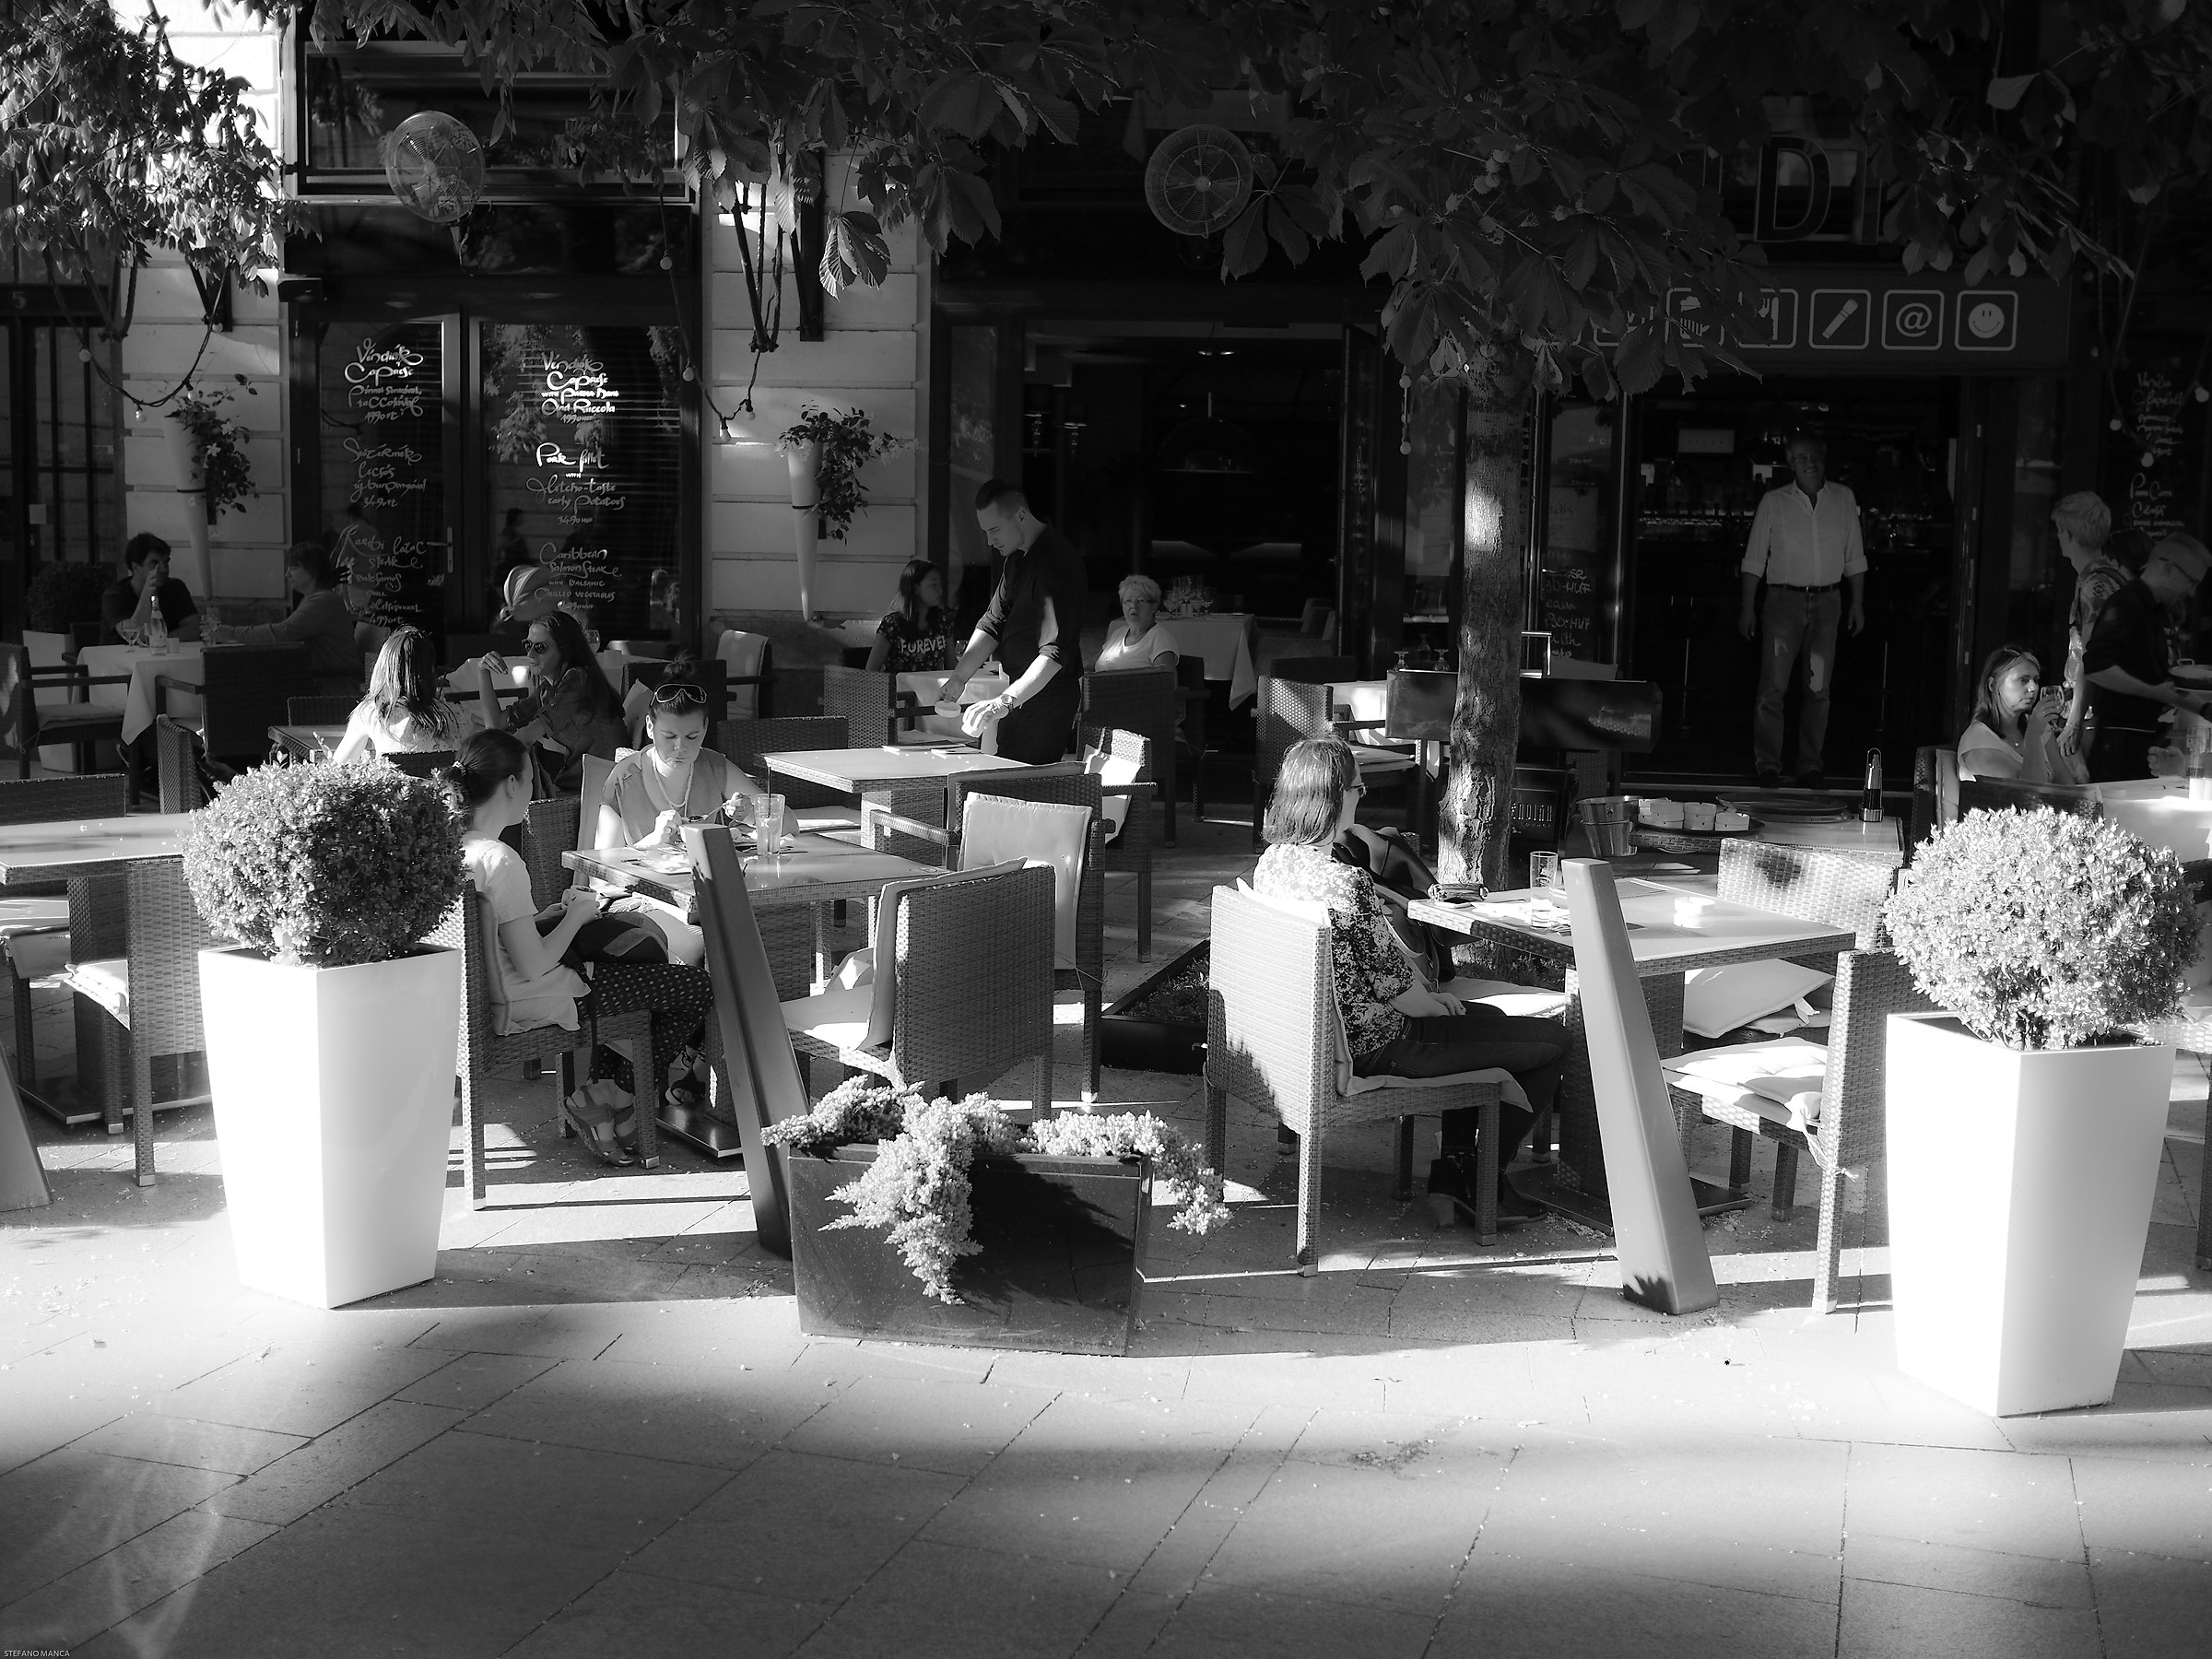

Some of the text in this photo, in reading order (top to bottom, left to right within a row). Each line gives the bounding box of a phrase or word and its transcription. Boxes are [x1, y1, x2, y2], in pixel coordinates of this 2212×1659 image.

[12, 290, 26, 309] 5
[572, 398, 616, 414] Ruccola
[535, 442, 577, 467] Pork
